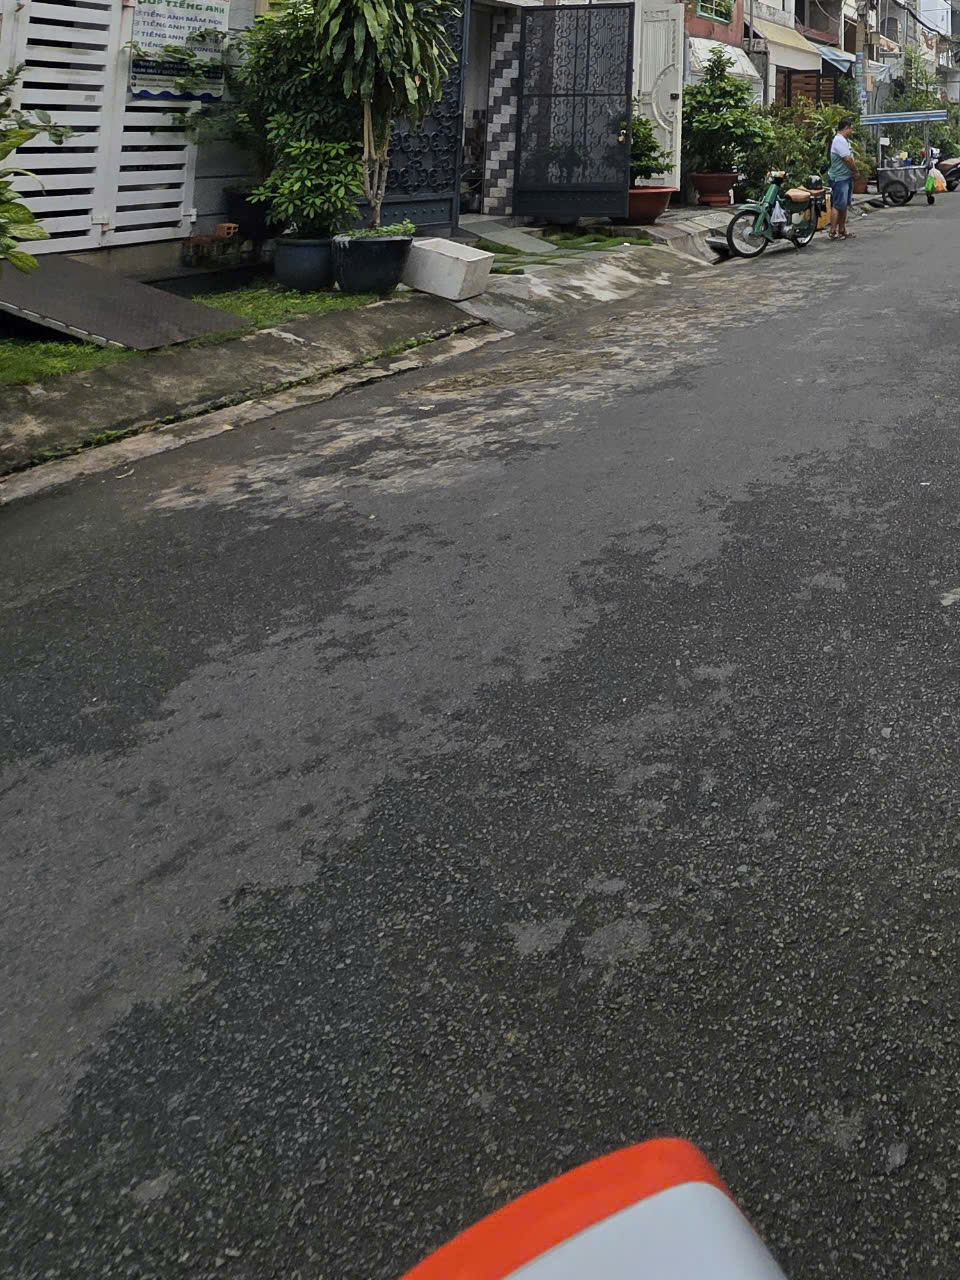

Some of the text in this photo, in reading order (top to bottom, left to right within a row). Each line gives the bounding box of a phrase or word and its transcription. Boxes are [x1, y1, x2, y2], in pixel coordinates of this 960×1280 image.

[205, 5, 225, 14] ANH
[143, 10, 166, 19] TIẾNG
[167, 14, 184, 22] ANH
[168, 23, 185, 31] ANH
[141, 31, 167, 39] TIẾNG
